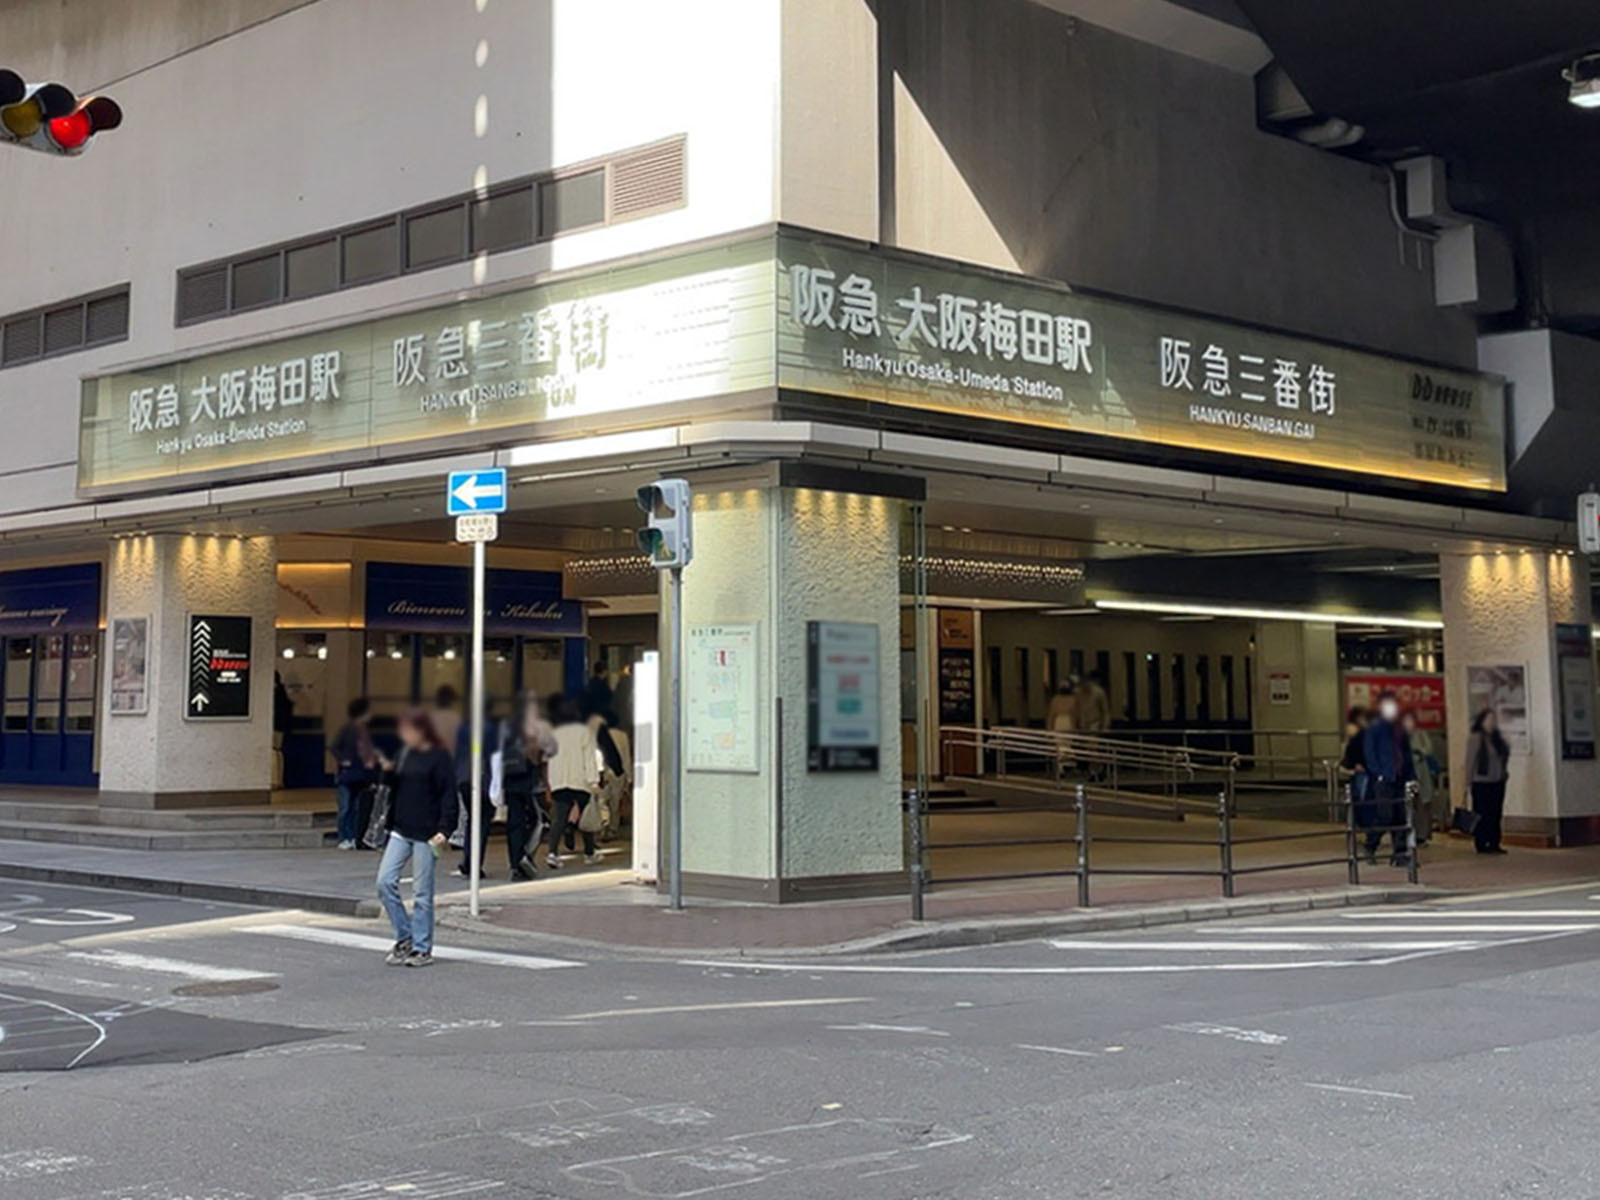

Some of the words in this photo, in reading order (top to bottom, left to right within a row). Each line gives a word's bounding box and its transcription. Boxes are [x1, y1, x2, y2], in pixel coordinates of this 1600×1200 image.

[789, 264, 881, 337] 阪急
[896, 287, 1093, 374] 大阪梅田駅
[128, 384, 180, 433] 阪急
[189, 350, 340, 424] 大阪梅田駅
[842, 349, 901, 376] Hankyu
[906, 359, 1010, 392] Osaka-Umeda
[1013, 376, 1064, 400] Station
[1160, 336, 1337, 416] 阪急三番街
[156, 437, 192, 455] Hankyu
[266, 418, 306, 437] Station
[1189, 405, 1241, 428] HANKYU
